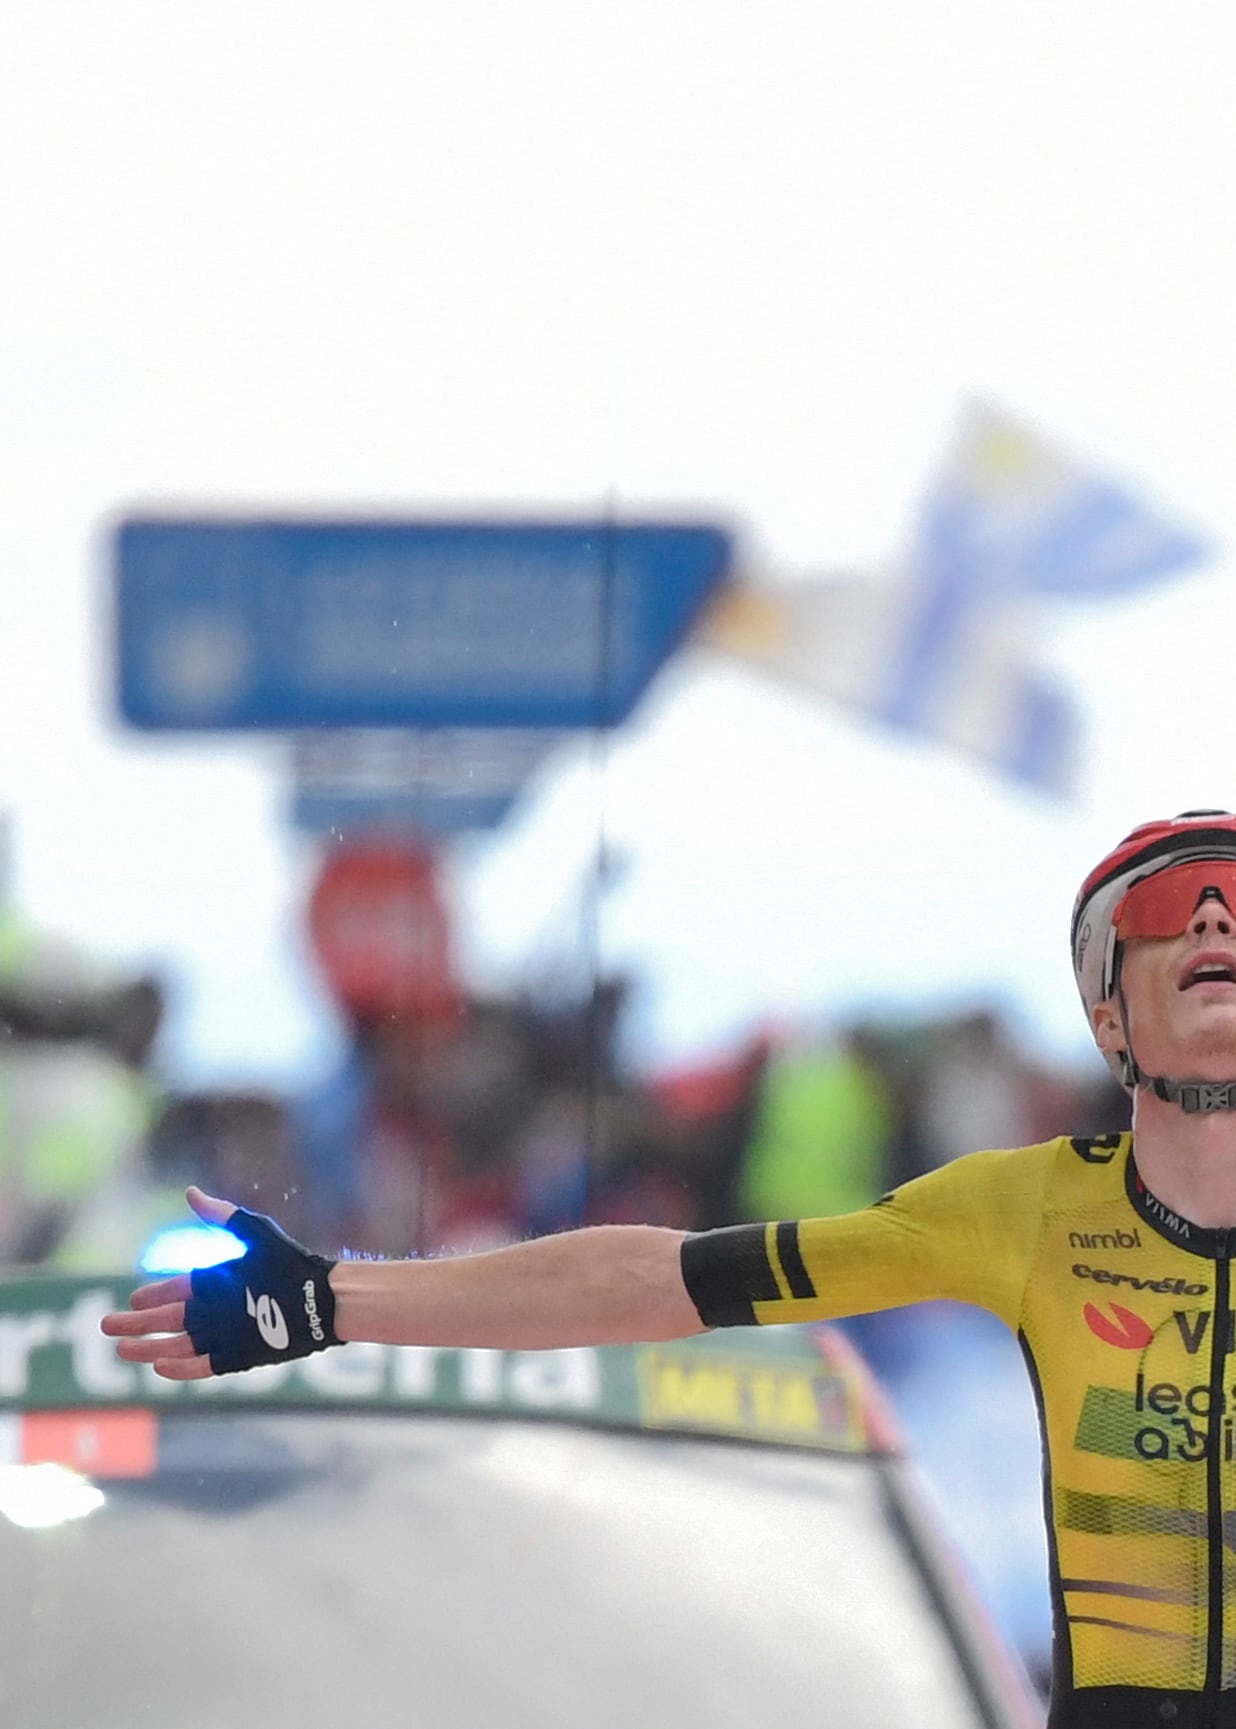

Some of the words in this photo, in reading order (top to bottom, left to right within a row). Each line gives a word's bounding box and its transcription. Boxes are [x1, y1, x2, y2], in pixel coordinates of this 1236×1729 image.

[1068, 1228, 1142, 1249] nimbl
[1145, 1192, 1191, 1239] VISMA
[302, 1279, 325, 1342] GripGrab
